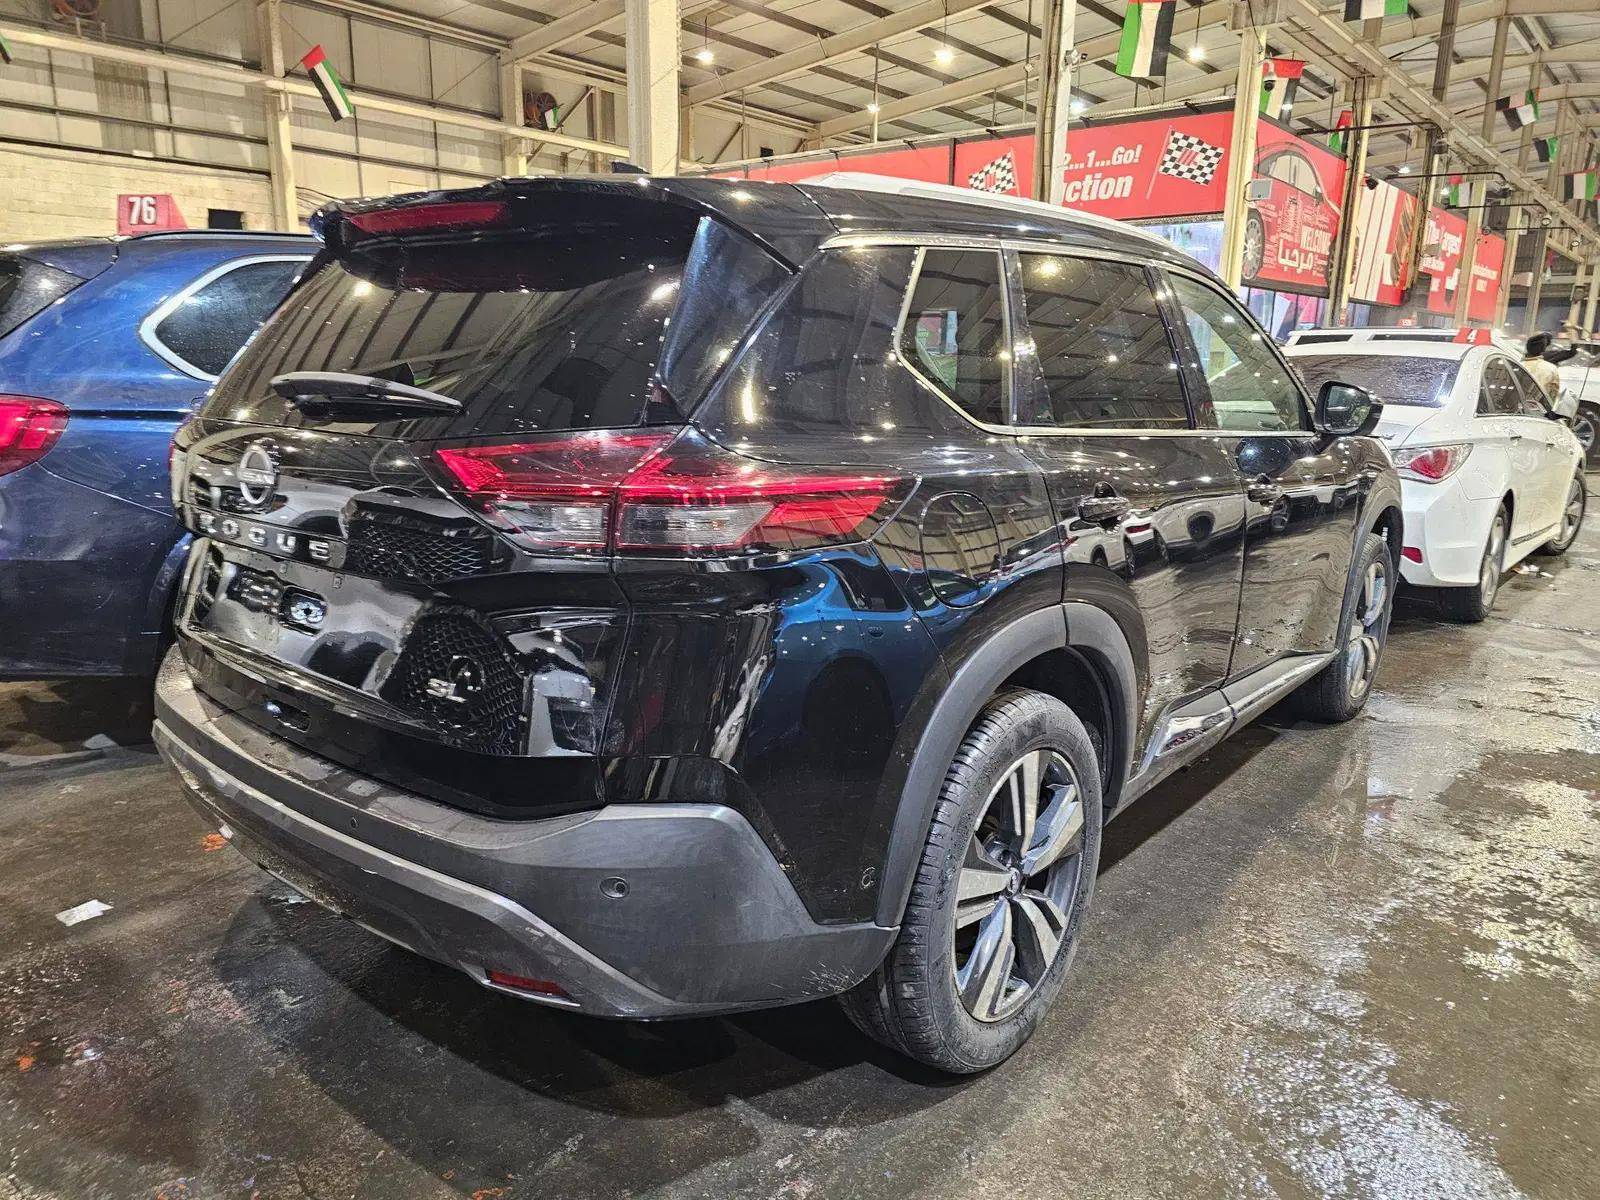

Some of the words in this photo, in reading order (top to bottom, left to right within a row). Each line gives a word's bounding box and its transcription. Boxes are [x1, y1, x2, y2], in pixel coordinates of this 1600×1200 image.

[1062, 172, 1133, 203] ction
[128, 196, 157, 225] 76
[1278, 239, 1314, 274] مرحبا
[1467, 328, 1478, 343] 4
[200, 514, 330, 561] ROGUE
